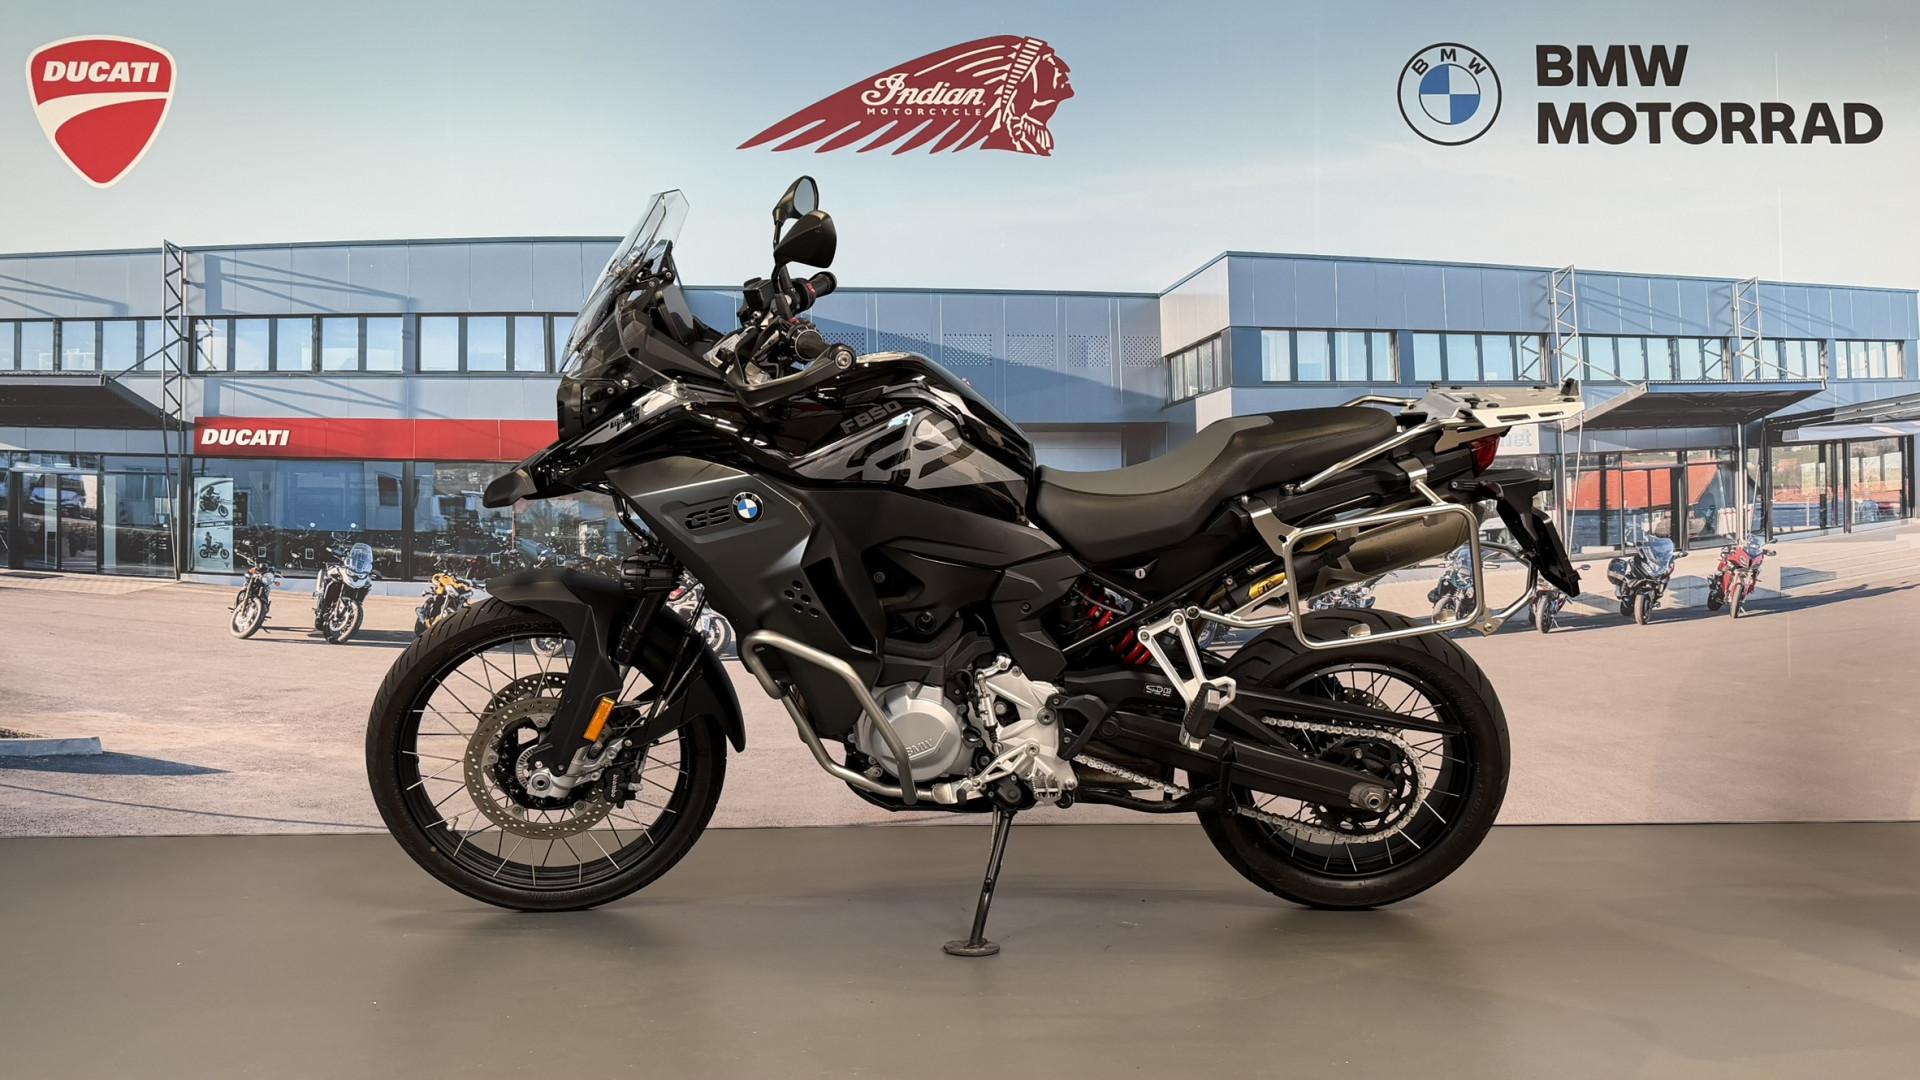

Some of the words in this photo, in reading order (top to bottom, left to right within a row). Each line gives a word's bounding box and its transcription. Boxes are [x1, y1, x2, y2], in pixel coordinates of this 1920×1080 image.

[42, 60, 160, 83] DUCATI
[1411, 48, 1487, 76] BMW
[1536, 44, 1689, 87] BMW
[860, 73, 986, 106] Indian
[866, 107, 982, 116] MOTORCYCLE
[1537, 101, 1884, 145] MOTORRAD
[839, 400, 903, 434] F850
[201, 428, 291, 446] DUCATI
[684, 504, 731, 531] GS
[610, 773, 620, 798] brembo
